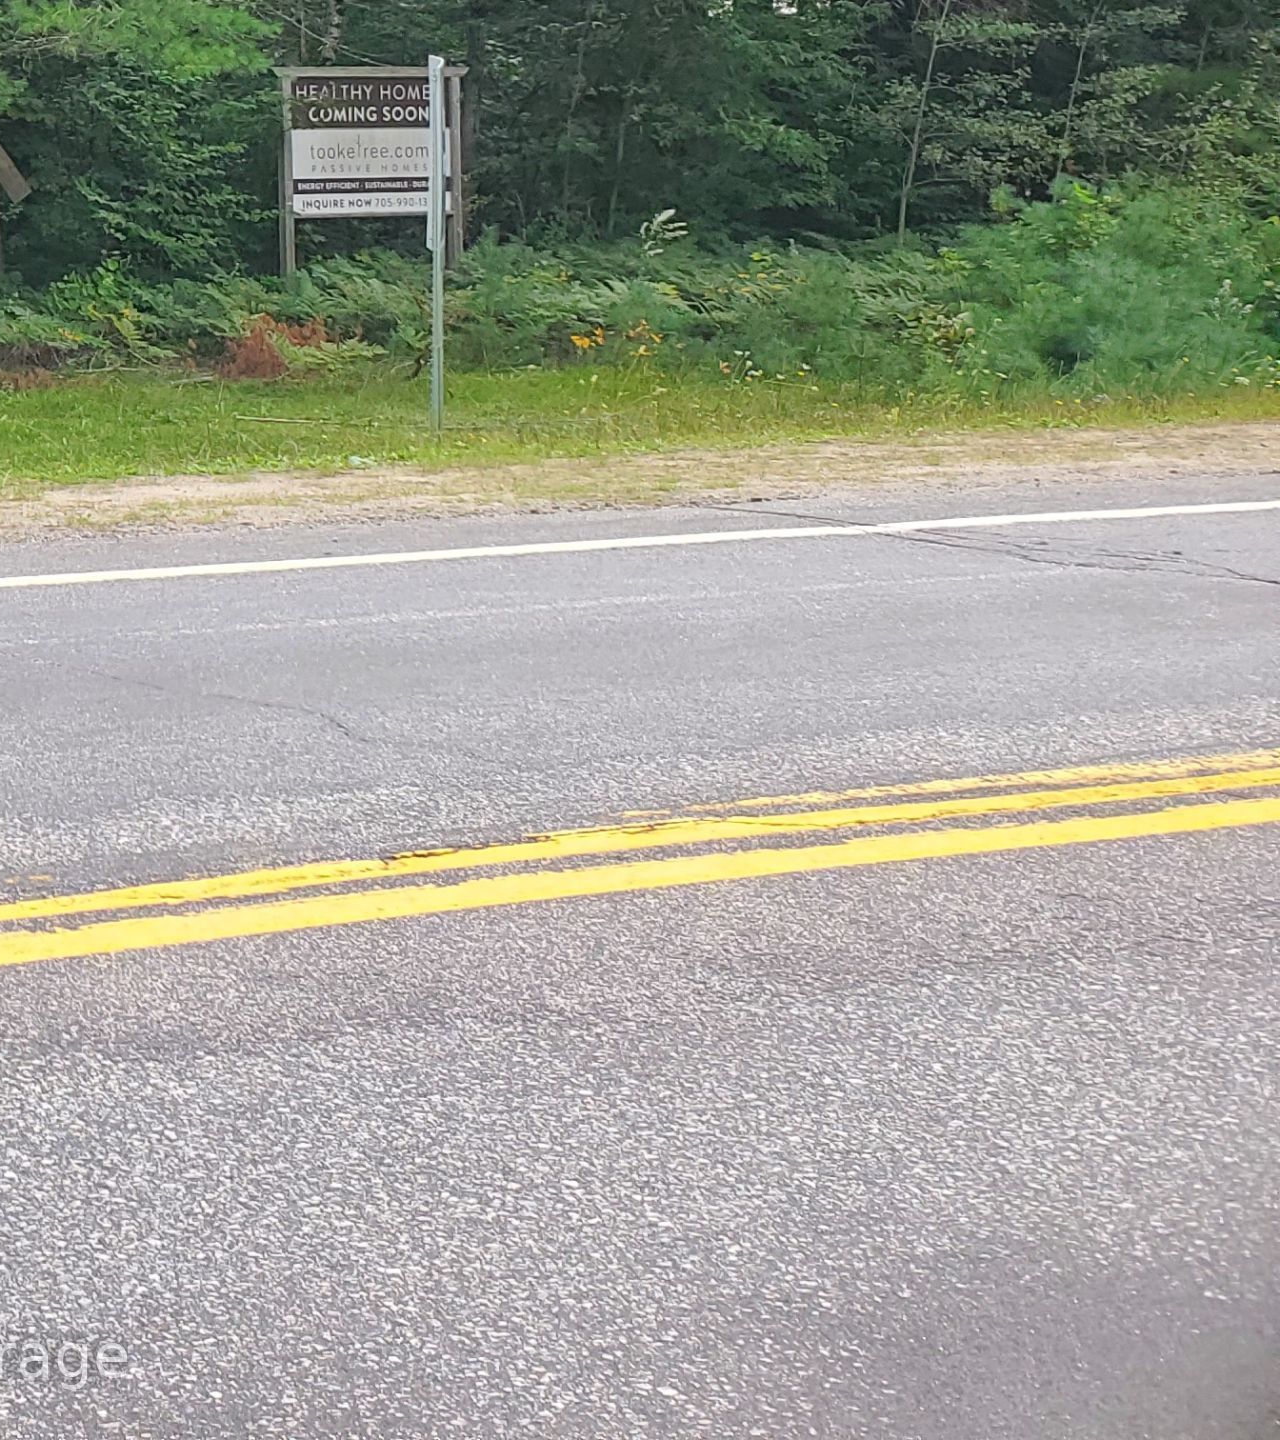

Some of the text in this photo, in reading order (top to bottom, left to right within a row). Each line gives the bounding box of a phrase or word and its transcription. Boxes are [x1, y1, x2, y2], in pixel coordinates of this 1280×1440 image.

[380, 84, 430, 100] HOME
[308, 106, 429, 122] COMING SOON
[312, 163, 428, 173] PASSIVE HOMES
[302, 197, 428, 210] INQUIRE NOW 705-990-13
